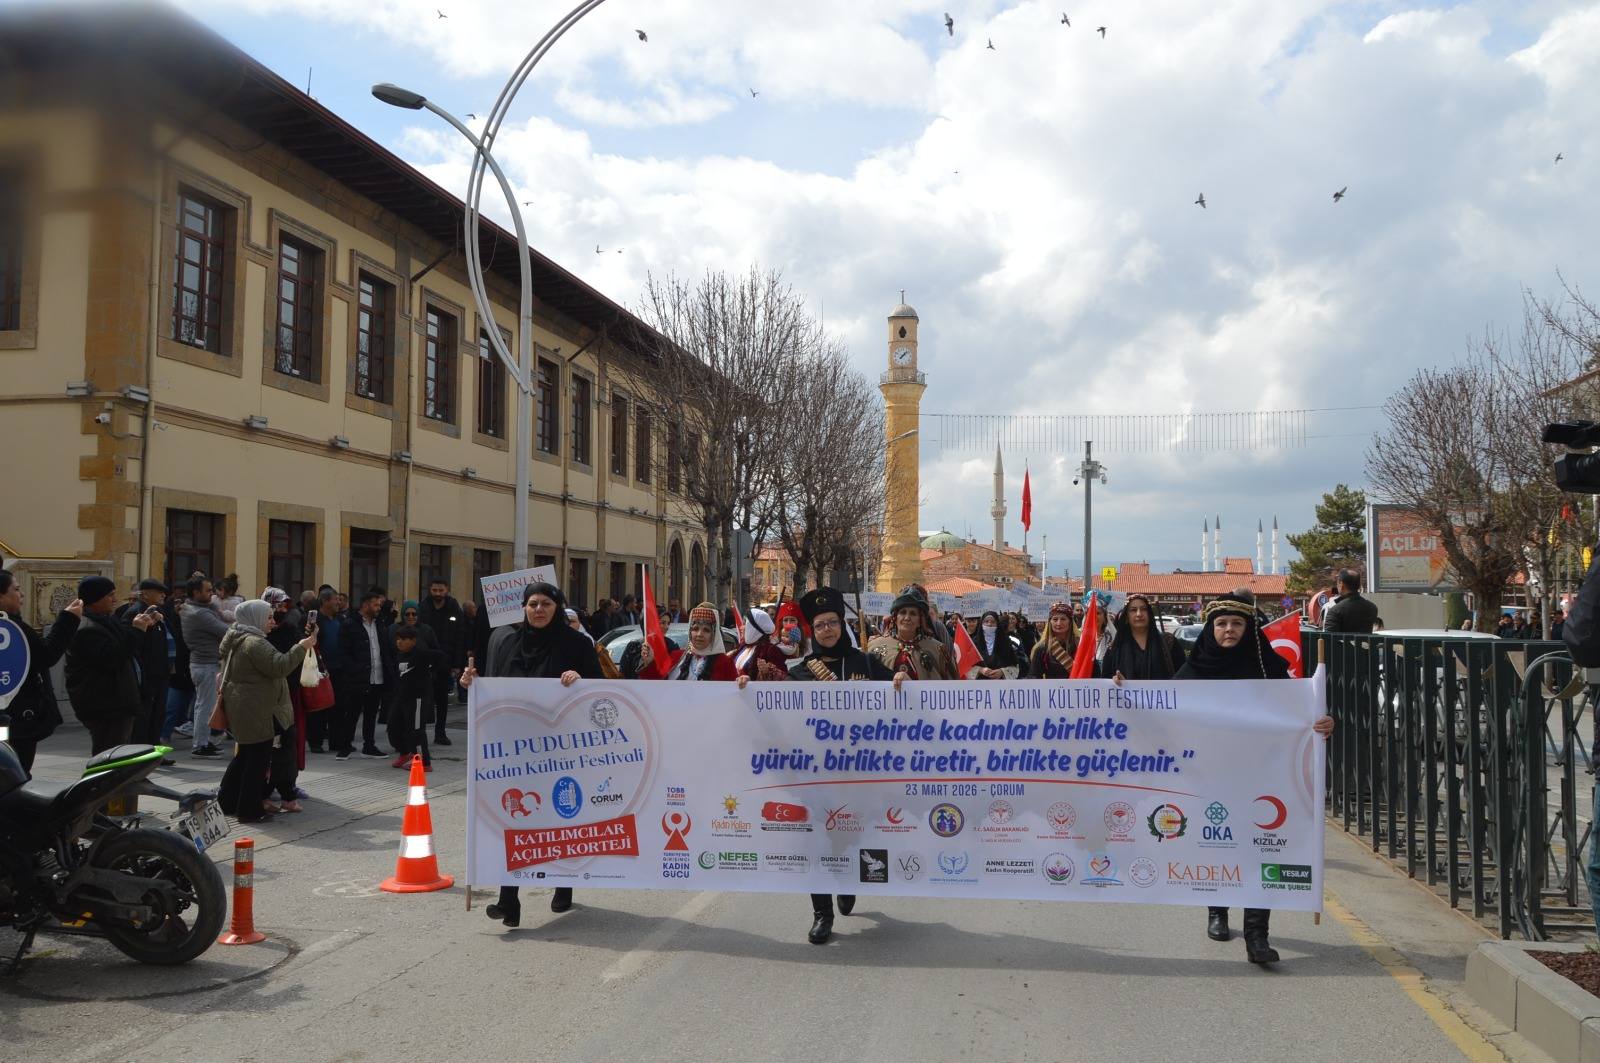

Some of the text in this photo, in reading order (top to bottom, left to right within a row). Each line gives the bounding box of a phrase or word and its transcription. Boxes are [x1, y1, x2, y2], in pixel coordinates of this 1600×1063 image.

[484, 574, 545, 593] KADINLAR
[756, 690, 804, 712] ÇORUM
[811, 688, 887, 710] BELEDİYESİ
[920, 689, 992, 710] PUDUHEPA
[1000, 689, 1041, 710] KADIN
[1049, 686, 1100, 709] KÜLTÜR
[1108, 687, 1177, 710] FESTİVALİ
[850, 718, 935, 746] şehirde
[939, 718, 1038, 741] kadınlar
[1042, 716, 1128, 740] birlikte
[514, 727, 629, 756] PUDUHEPA
[475, 748, 644, 782] Kadın Kültür Festivali
[751, 749, 818, 774] yürür,
[824, 749, 906, 771] birlikte
[910, 749, 981, 774] üretir,
[987, 749, 1071, 772] birlikte
[590, 794, 623, 804] ÇORUM
[905, 784, 918, 796] 23
[922, 784, 948, 796] MART
[952, 784, 977, 796] 2026
[990, 784, 1025, 797] ÇORUM
[188, 803, 222, 832] 19 AFK
[202, 825, 221, 845] 844
[514, 823, 625, 846] KATILIMCILAR
[1202, 826, 1233, 841] OKA
[1253, 837, 1288, 846] KIZILAY
[510, 836, 632, 864] AÇILIŞ KORTEJİ
[718, 852, 758, 862] NEFES
[662, 862, 690, 870] KADIN
[1167, 862, 1241, 882] KADEM
[1261, 882, 1312, 891] ÇORUM ŞUBESİ
